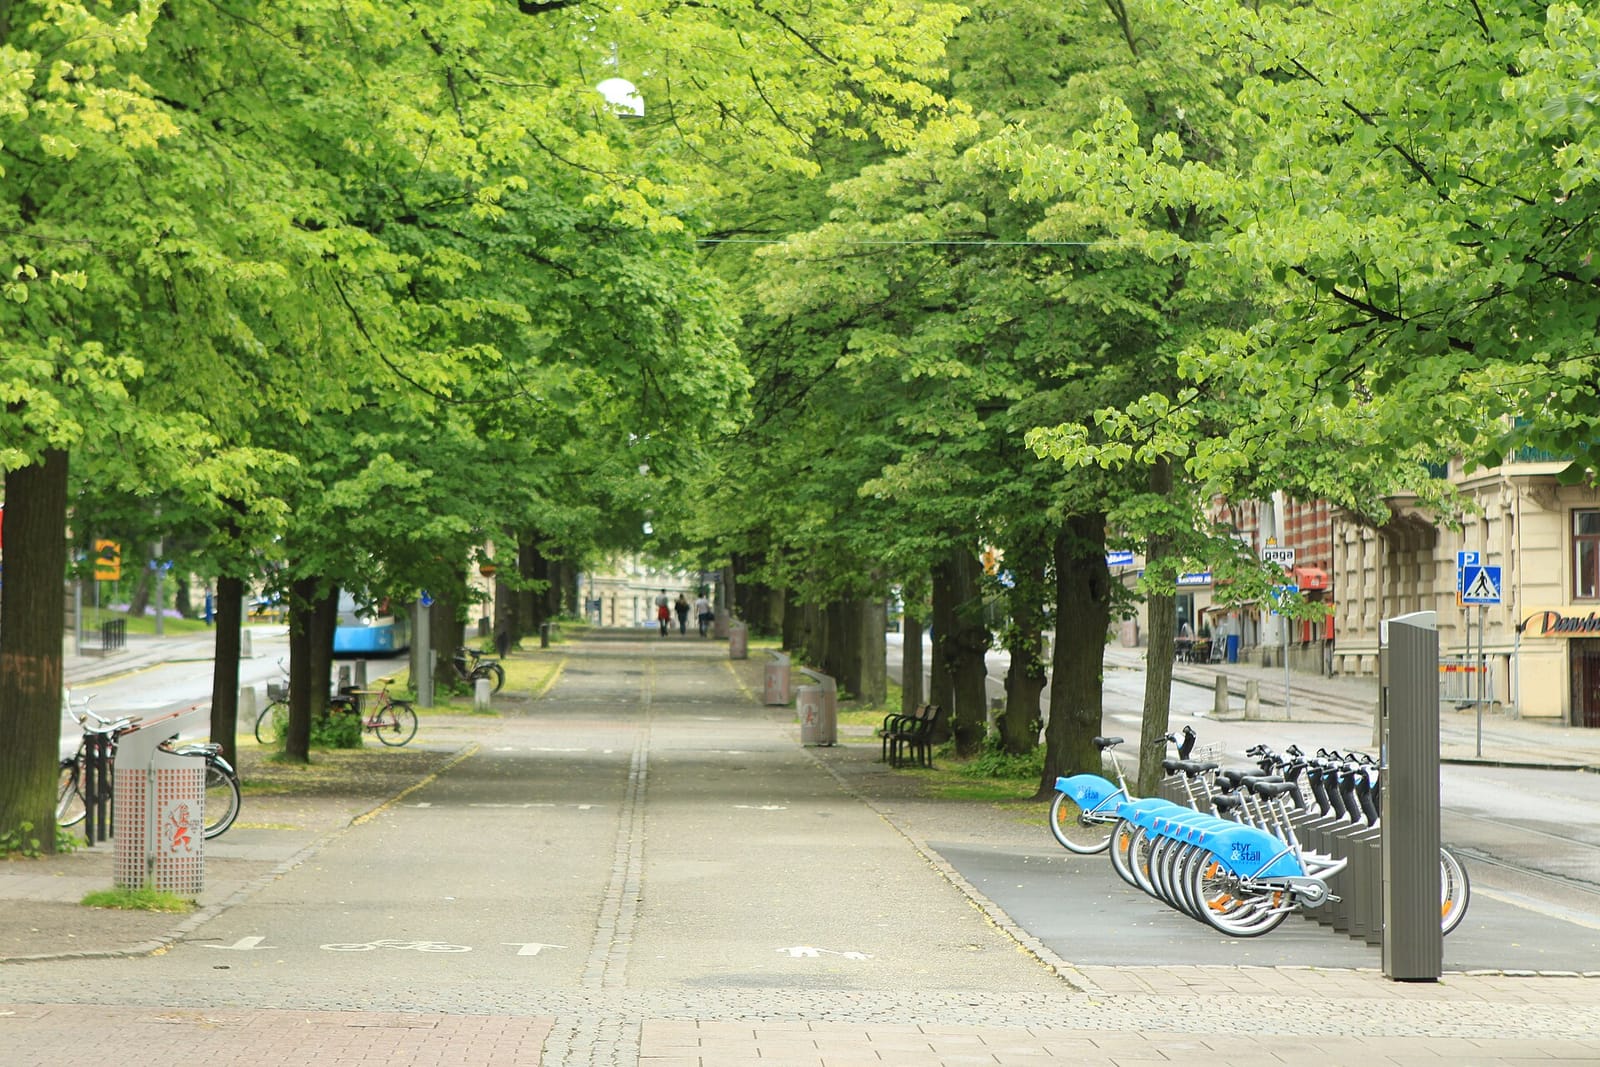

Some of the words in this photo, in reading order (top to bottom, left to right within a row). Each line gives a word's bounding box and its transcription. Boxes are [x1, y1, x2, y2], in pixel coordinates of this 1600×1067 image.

[1265, 551, 1293, 561] gaga
[1464, 553, 1475, 565] P
[1231, 841, 1251, 853] styr
